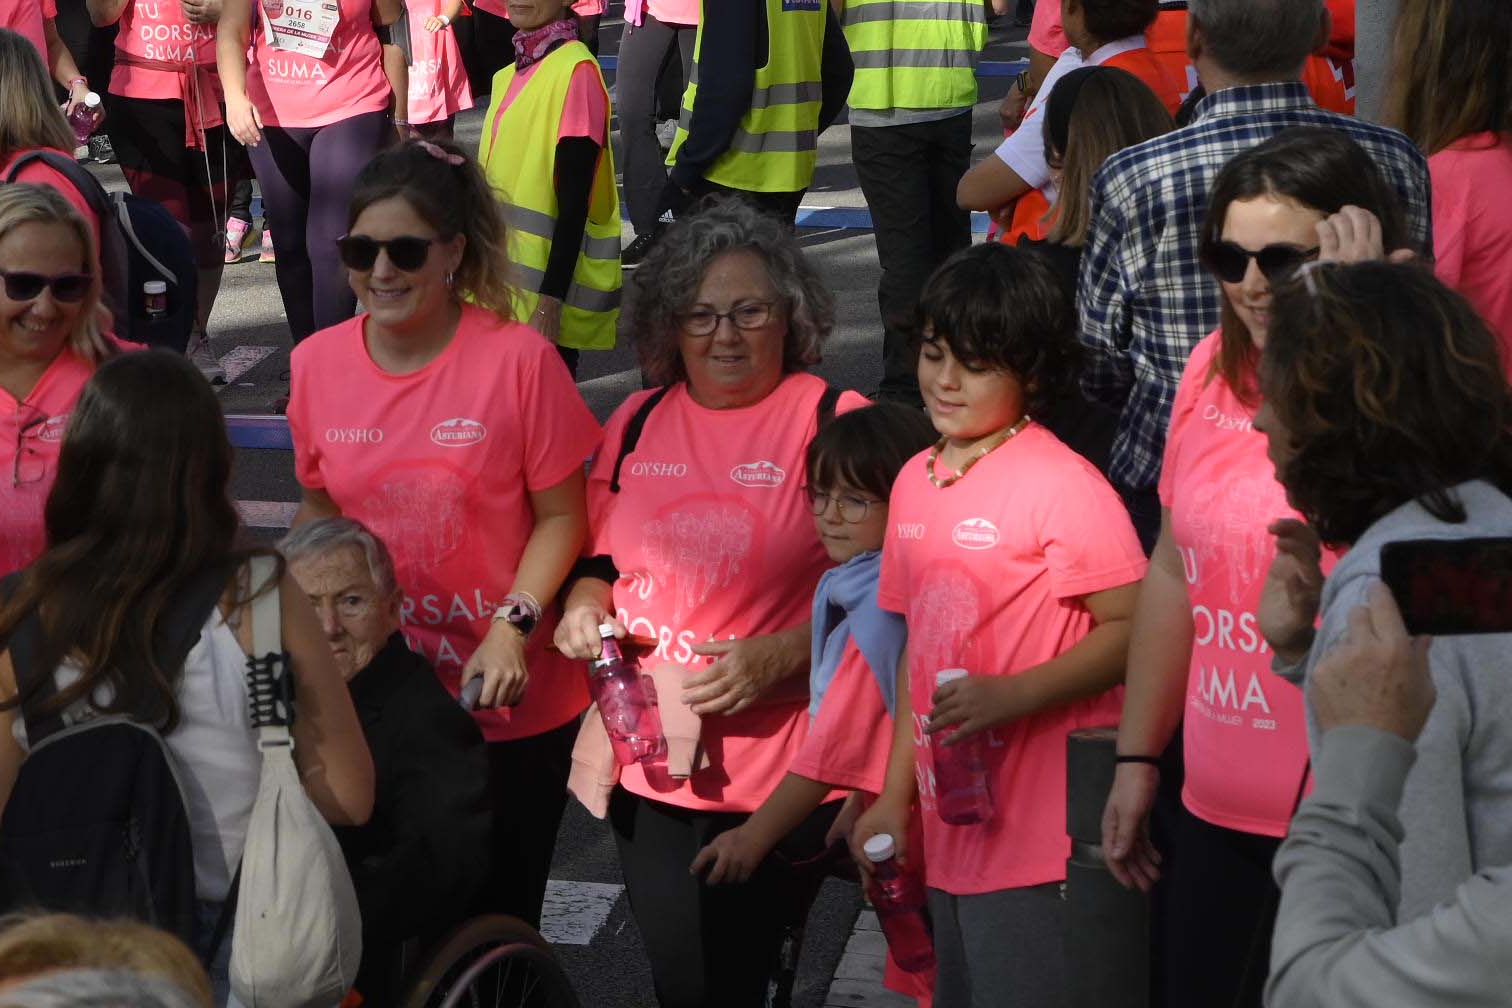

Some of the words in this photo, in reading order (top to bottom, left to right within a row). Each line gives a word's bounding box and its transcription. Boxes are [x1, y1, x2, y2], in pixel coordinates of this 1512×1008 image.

[135, 2, 159, 20] TU
[285, 6, 313, 21] 016
[144, 43, 196, 62] SUMA
[268, 58, 327, 79] SUMA
[325, 427, 384, 443] OYSHO
[436, 429, 482, 441] ASTURIANA
[631, 462, 687, 478] OYSHO
[734, 470, 781, 482] ASTURIANA
